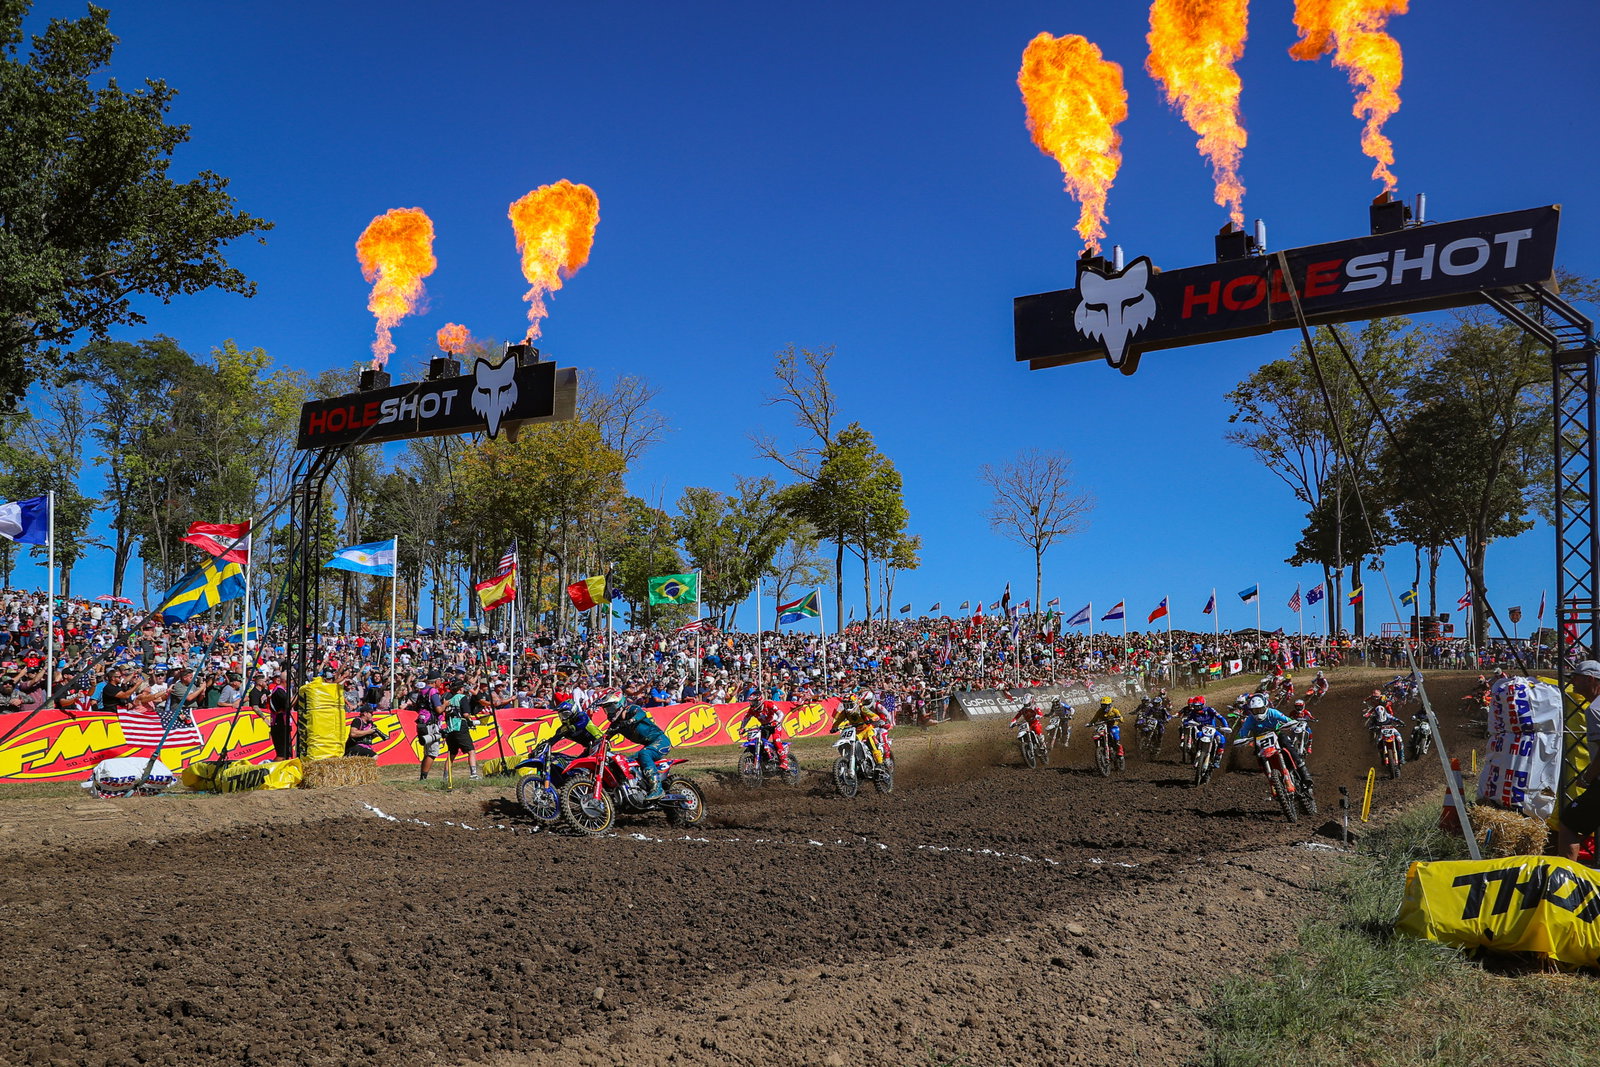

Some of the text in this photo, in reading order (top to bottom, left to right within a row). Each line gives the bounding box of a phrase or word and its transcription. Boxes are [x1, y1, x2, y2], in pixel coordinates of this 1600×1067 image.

[1181, 227, 1534, 319] HOLESHOT
[308, 388, 458, 436] HOLESHOT
[962, 698, 995, 707] GoPro
[1062, 689, 1087, 698] GoPro
[667, 706, 719, 748] FMF
[784, 704, 824, 738] FMF
[1260, 735, 1275, 747] 21
[660, 762, 669, 771] 3
